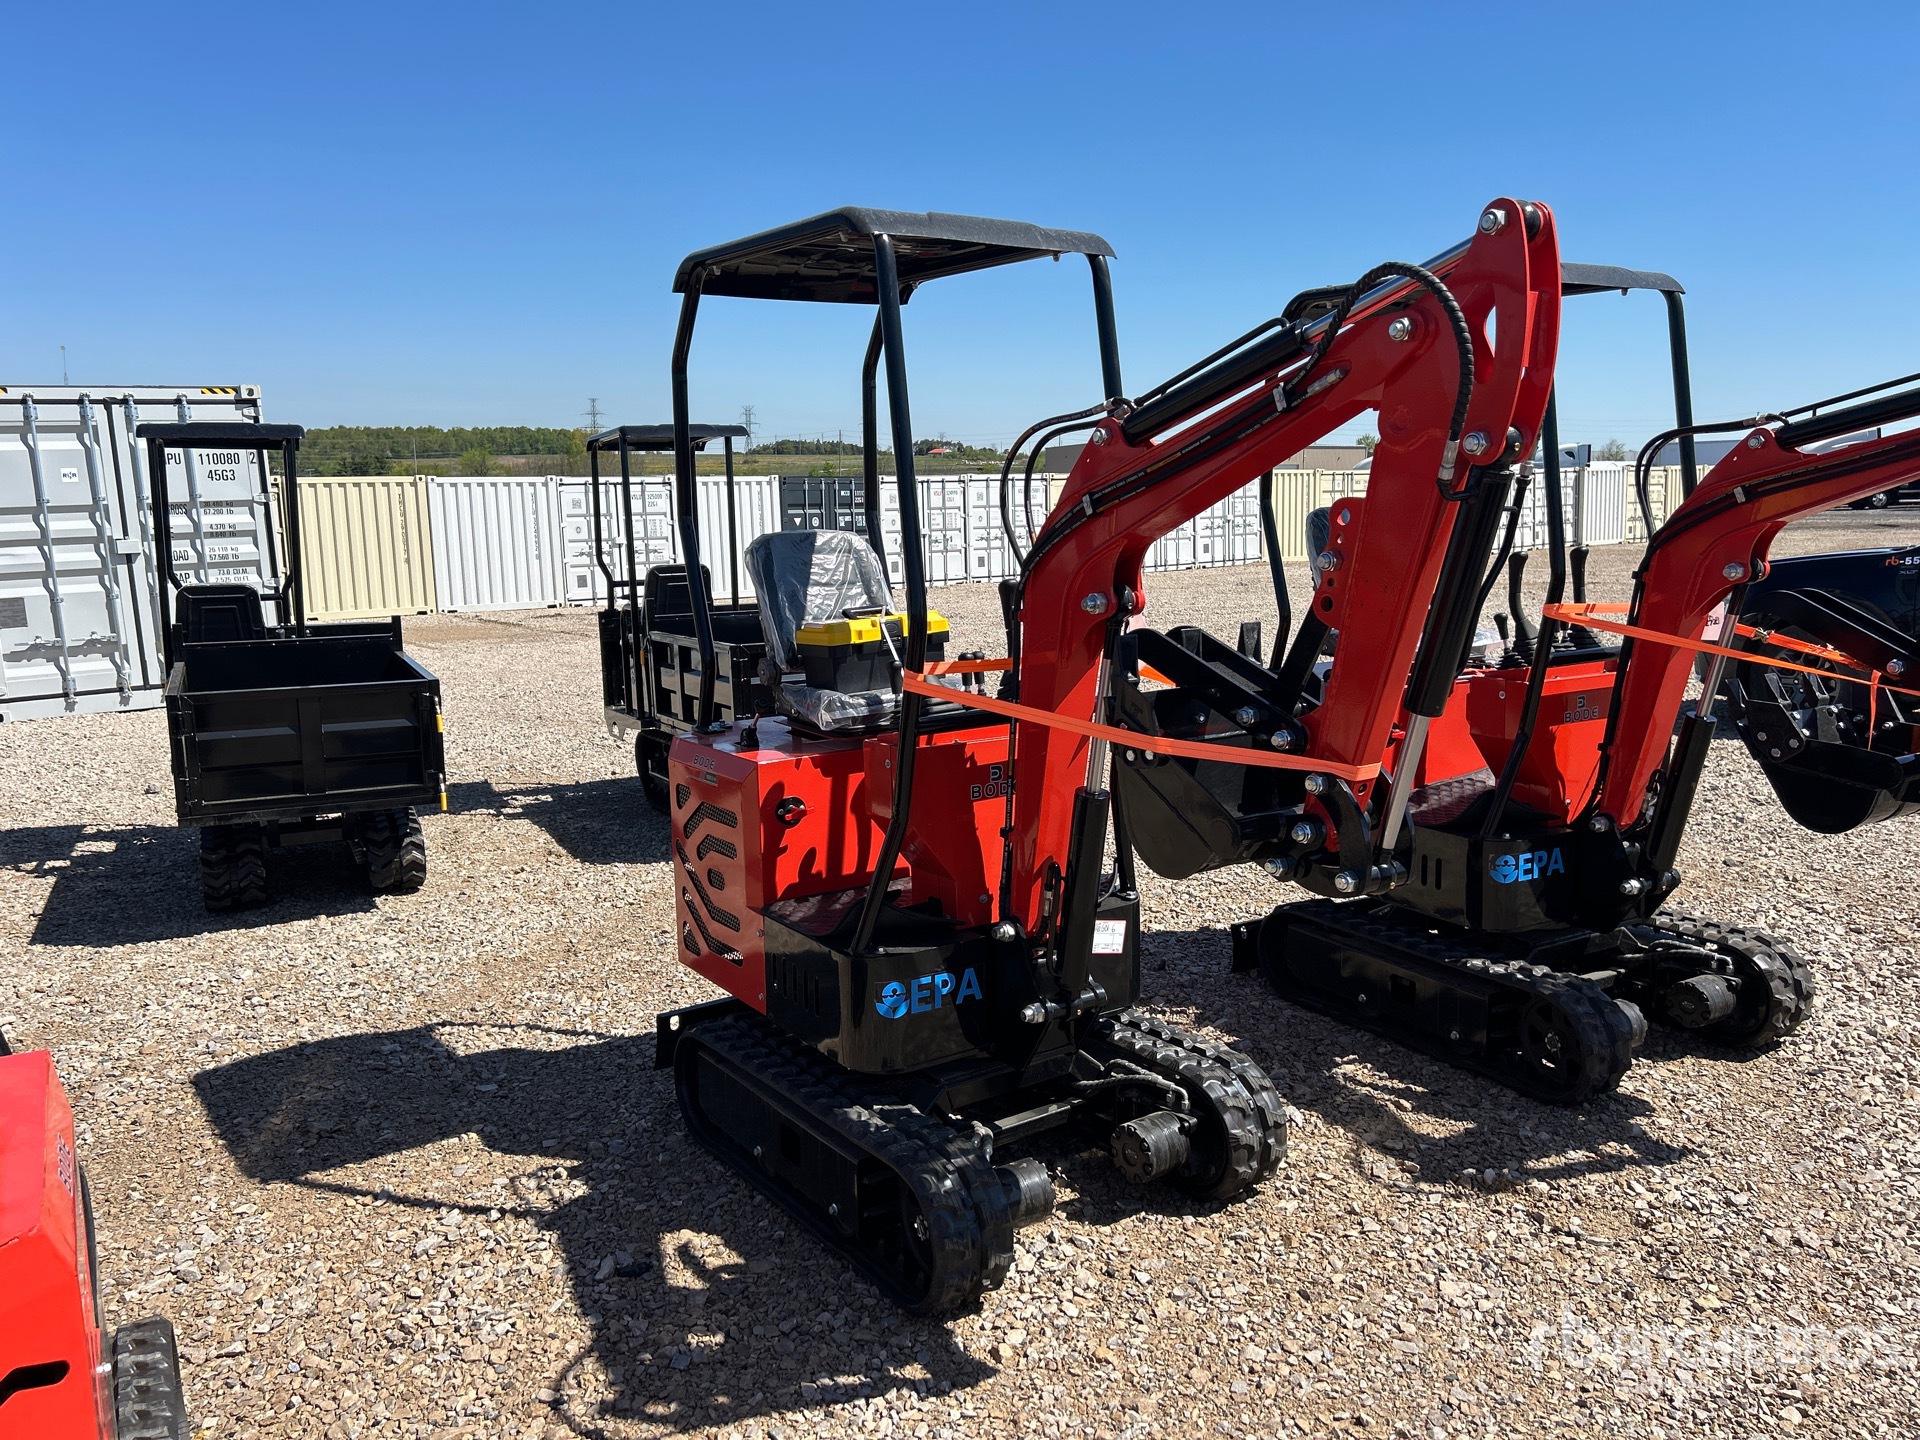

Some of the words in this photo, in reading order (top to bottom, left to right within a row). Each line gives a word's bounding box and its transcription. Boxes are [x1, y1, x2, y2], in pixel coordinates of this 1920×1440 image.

[198, 453, 240, 465] 110080
[249, 451, 257, 465] 2
[207, 469, 236, 481] 45G3
[203, 508, 224, 516] 67.200
[209, 523, 226, 531] 4.370
[228, 523, 237, 531] kg
[172, 550, 189, 562] OAD
[1564, 706, 1599, 724] BODE
[693, 754, 715, 770] BODE
[971, 780, 1016, 800] BOD
[1518, 847, 1565, 882] EPA
[910, 967, 983, 1015] EPA
[58, 1132, 73, 1197] BODE
